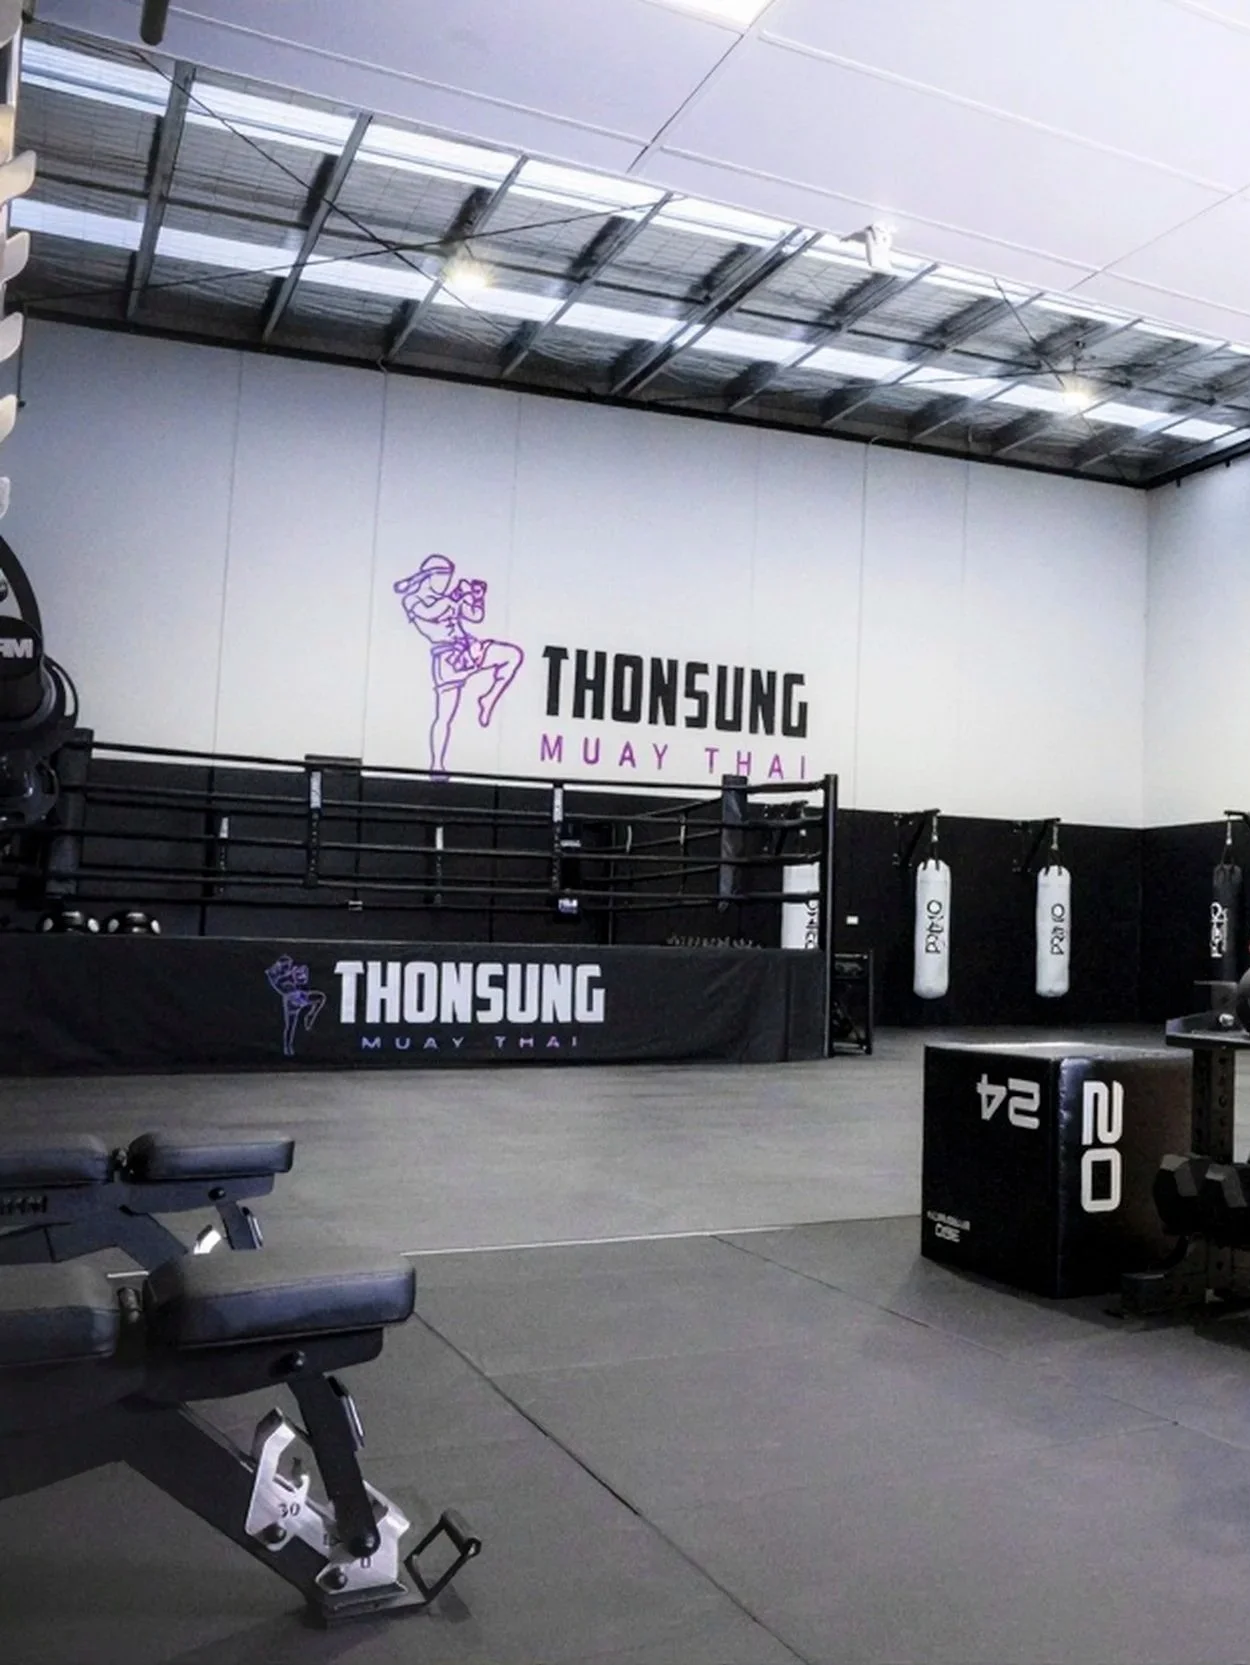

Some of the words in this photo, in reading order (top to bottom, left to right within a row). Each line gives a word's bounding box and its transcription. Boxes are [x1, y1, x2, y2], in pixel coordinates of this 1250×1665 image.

[541, 645, 808, 738] THONSUNG
[540, 733, 668, 770] MUAY
[705, 747, 806, 780] THAI
[334, 960, 606, 1023] THONSUNG
[361, 1036, 465, 1049] MUAY
[494, 1036, 578, 1048] THAI
[976, 1073, 1040, 1130] 24
[1080, 1080, 1124, 1213] 20
